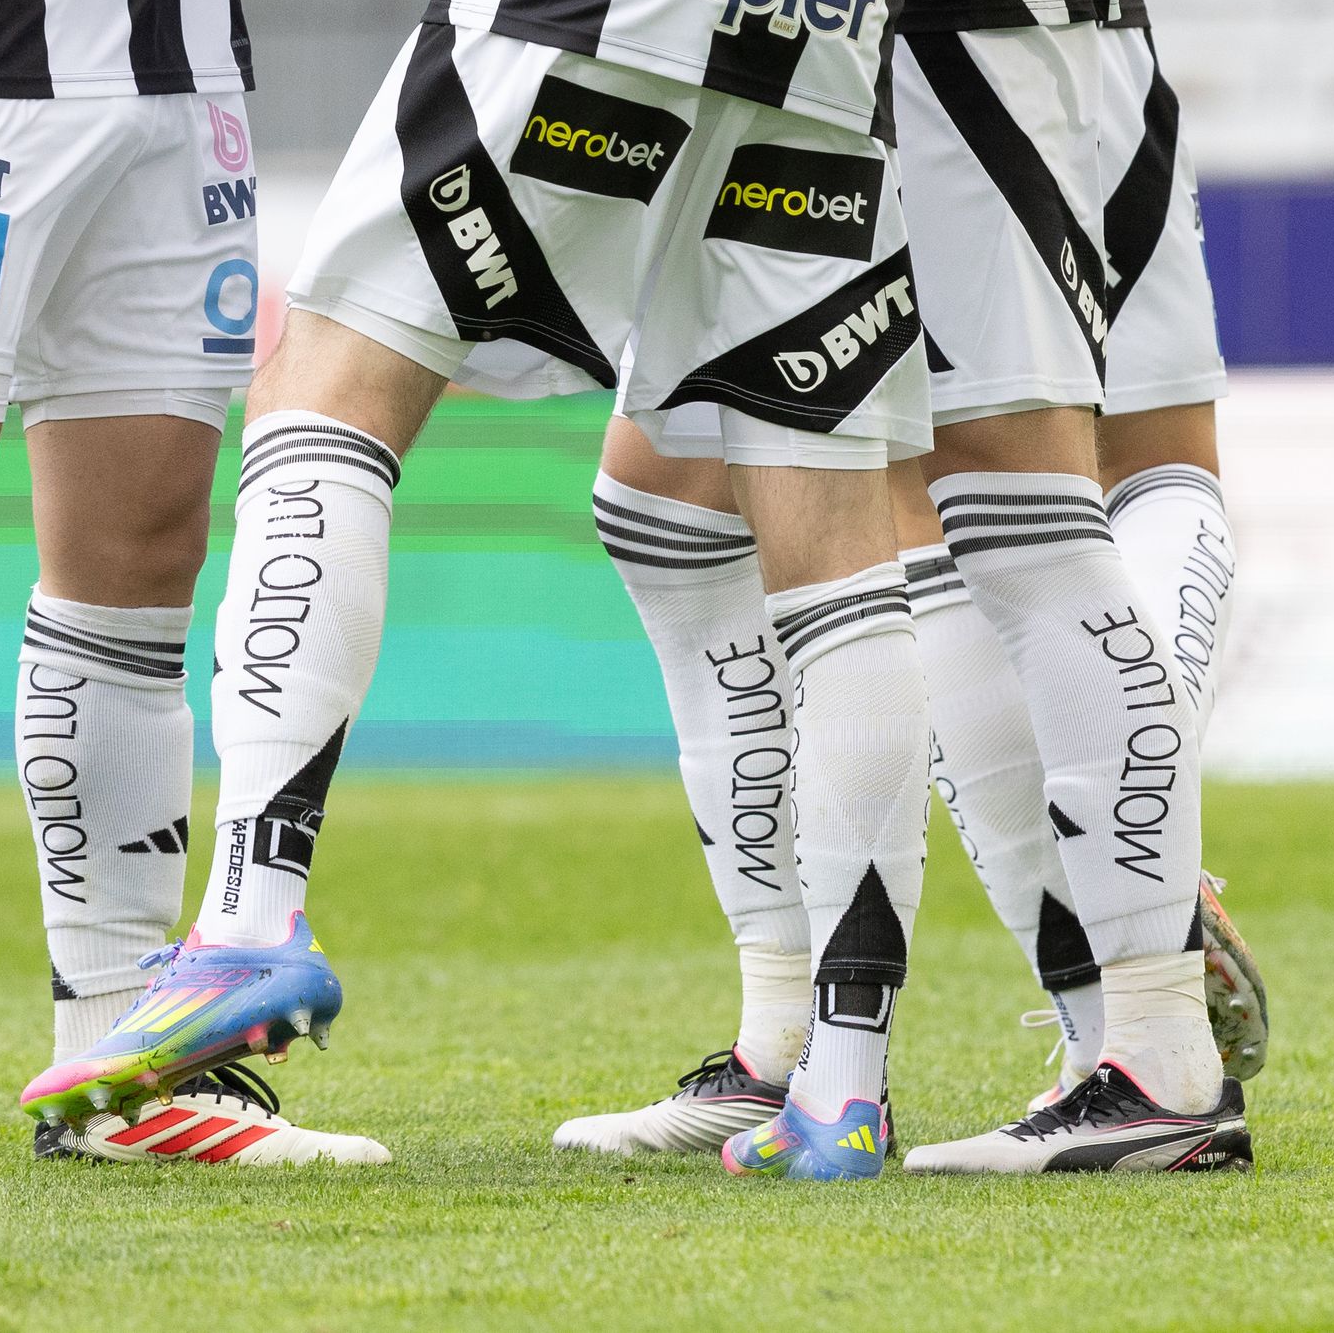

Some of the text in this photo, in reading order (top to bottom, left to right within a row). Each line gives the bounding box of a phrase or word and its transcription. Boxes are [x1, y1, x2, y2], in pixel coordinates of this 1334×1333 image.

[772, 19, 796, 34] MARKE
[524, 114, 665, 172] nerobet
[202, 176, 257, 226] BW
[718, 181, 868, 225] nerobet
[820, 274, 915, 370] BWT
[238, 479, 325, 718] MOLTO LUC
[23, 663, 88, 905] MOLTO LUC
[705, 634, 792, 892] MOLTO LUCE
[1079, 605, 1182, 884] MOLTO LUCE
